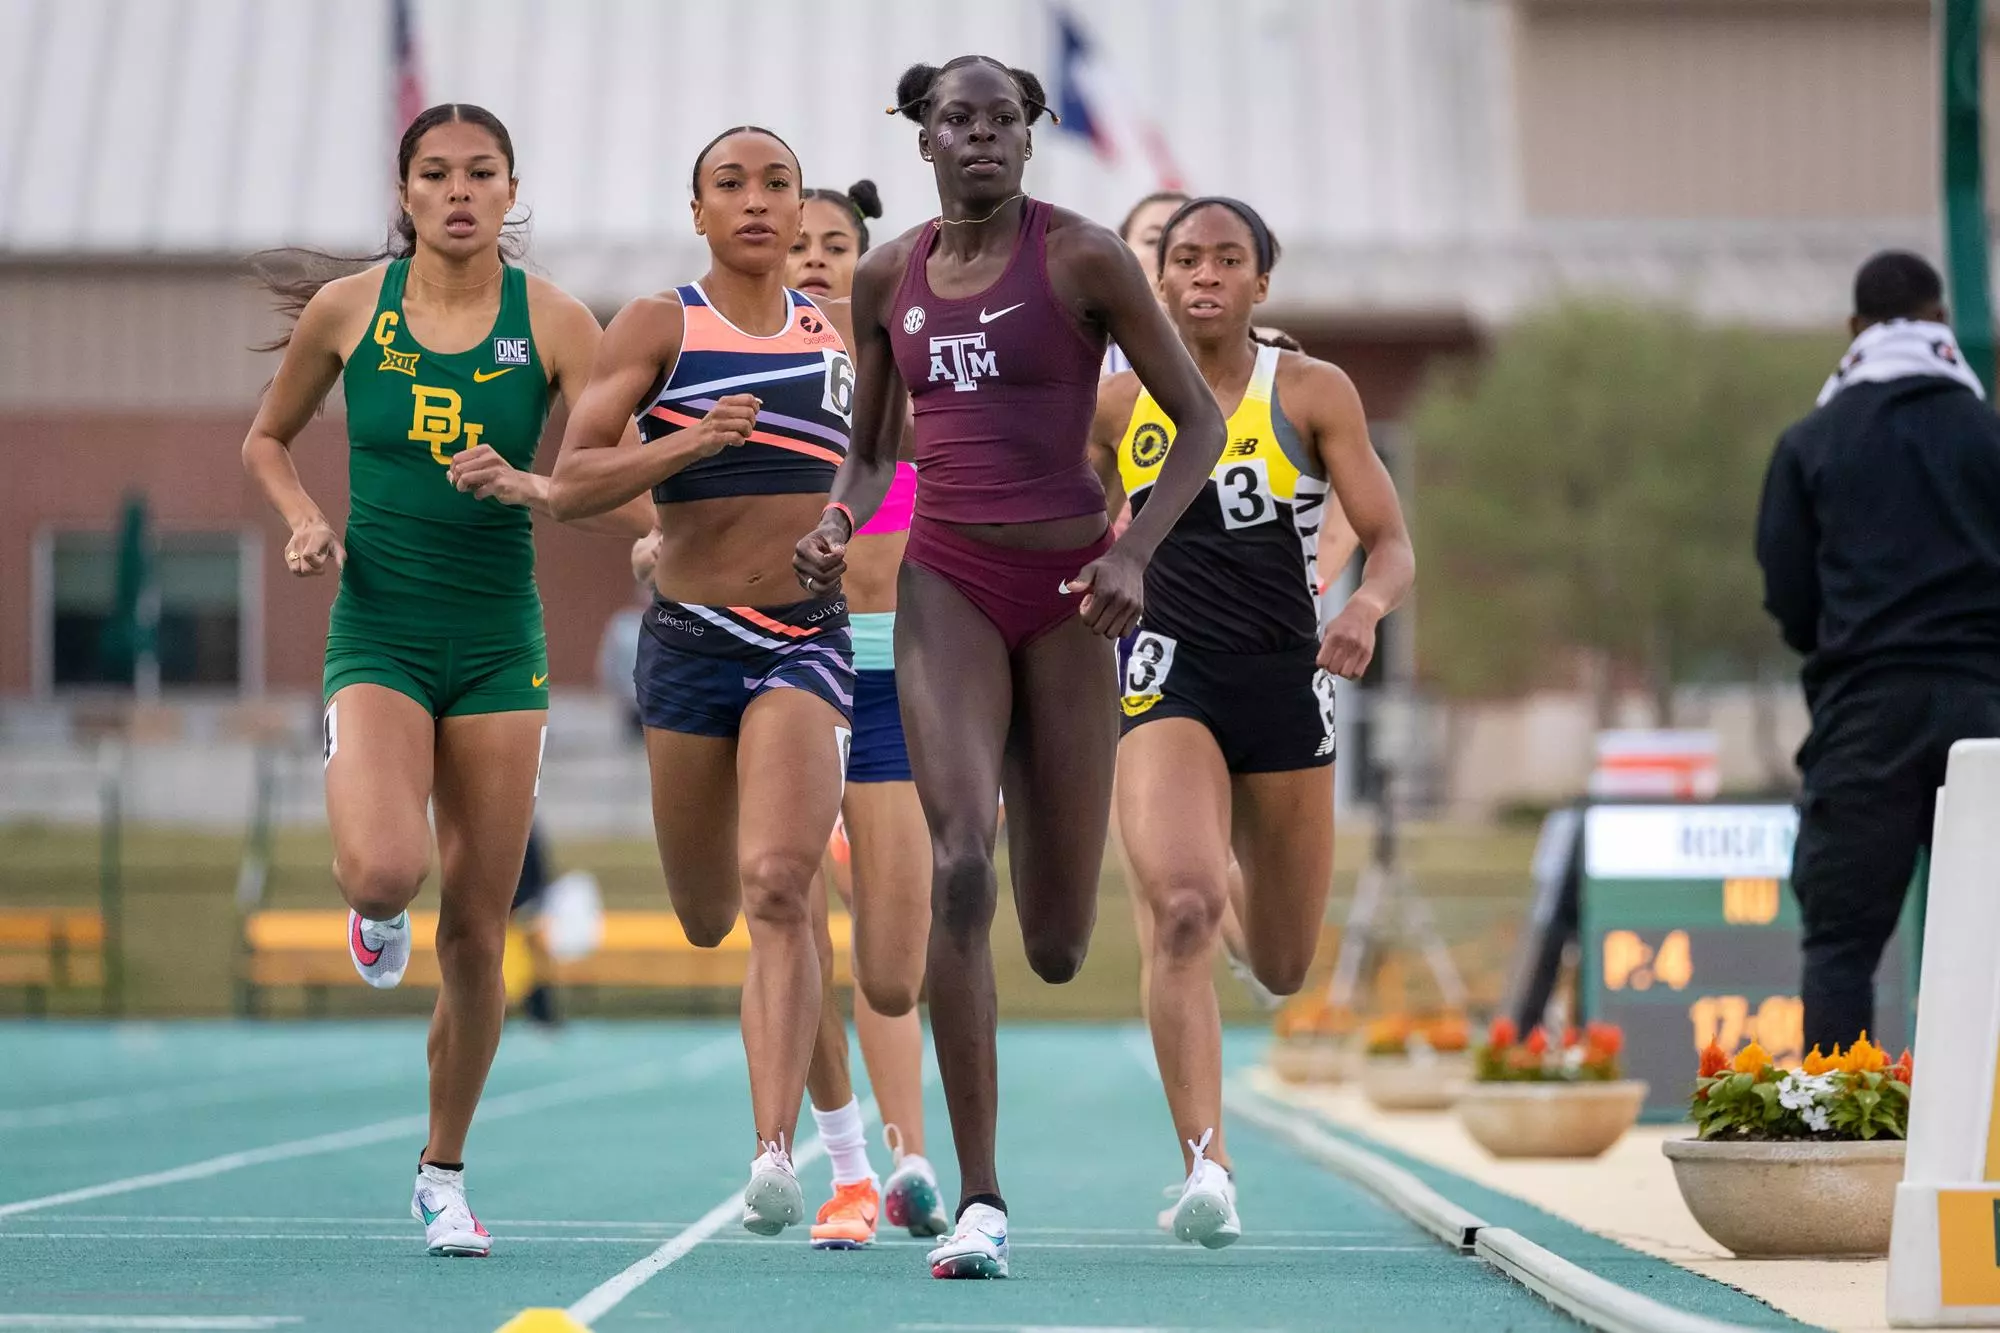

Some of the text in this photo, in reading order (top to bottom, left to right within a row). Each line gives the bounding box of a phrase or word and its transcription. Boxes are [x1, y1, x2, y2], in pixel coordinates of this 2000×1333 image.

[373, 311, 399, 346] C
[904, 308, 924, 333] SEC
[497, 340, 527, 358] ONE
[831, 356, 854, 416] 6
[408, 384, 483, 465] BU
[1224, 466, 1265, 523] 3
[1129, 637, 1164, 692] 3
